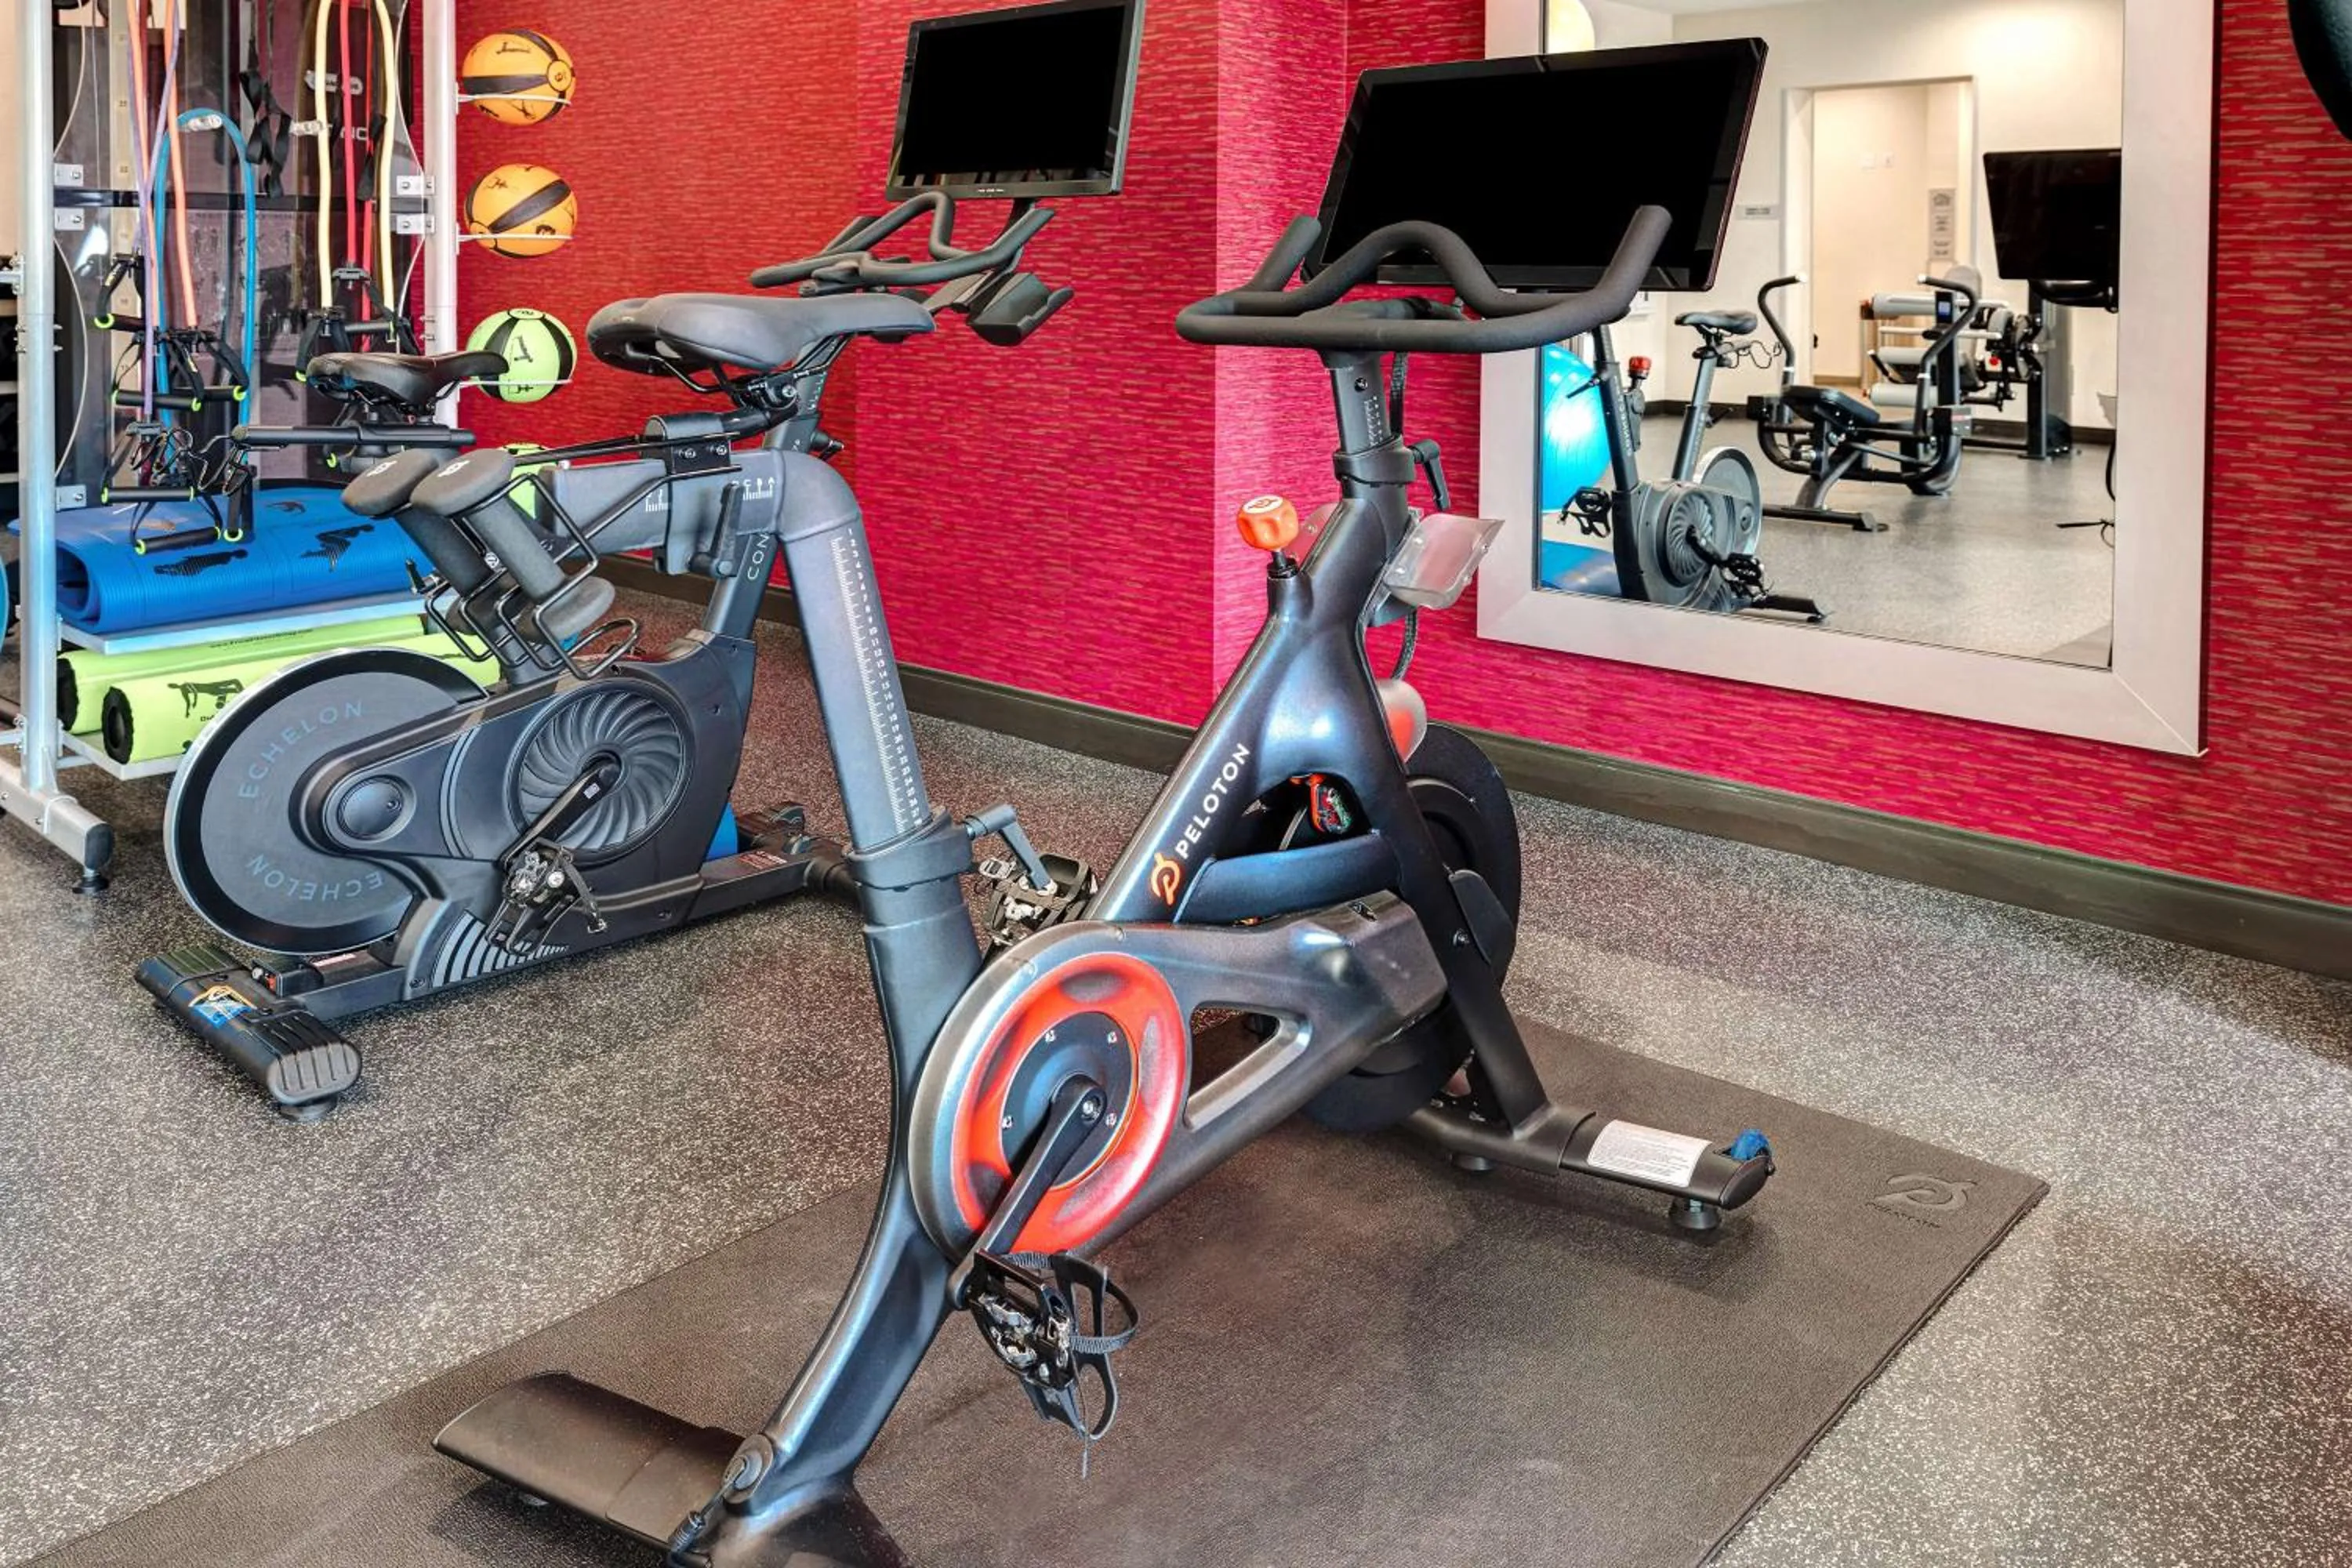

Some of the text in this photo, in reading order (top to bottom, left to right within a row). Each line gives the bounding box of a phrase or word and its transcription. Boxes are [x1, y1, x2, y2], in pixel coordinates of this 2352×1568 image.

[239, 700, 365, 799] ECHELON
[1175, 742, 1251, 859] PELOTON
[247, 853, 383, 902] ECHELON
